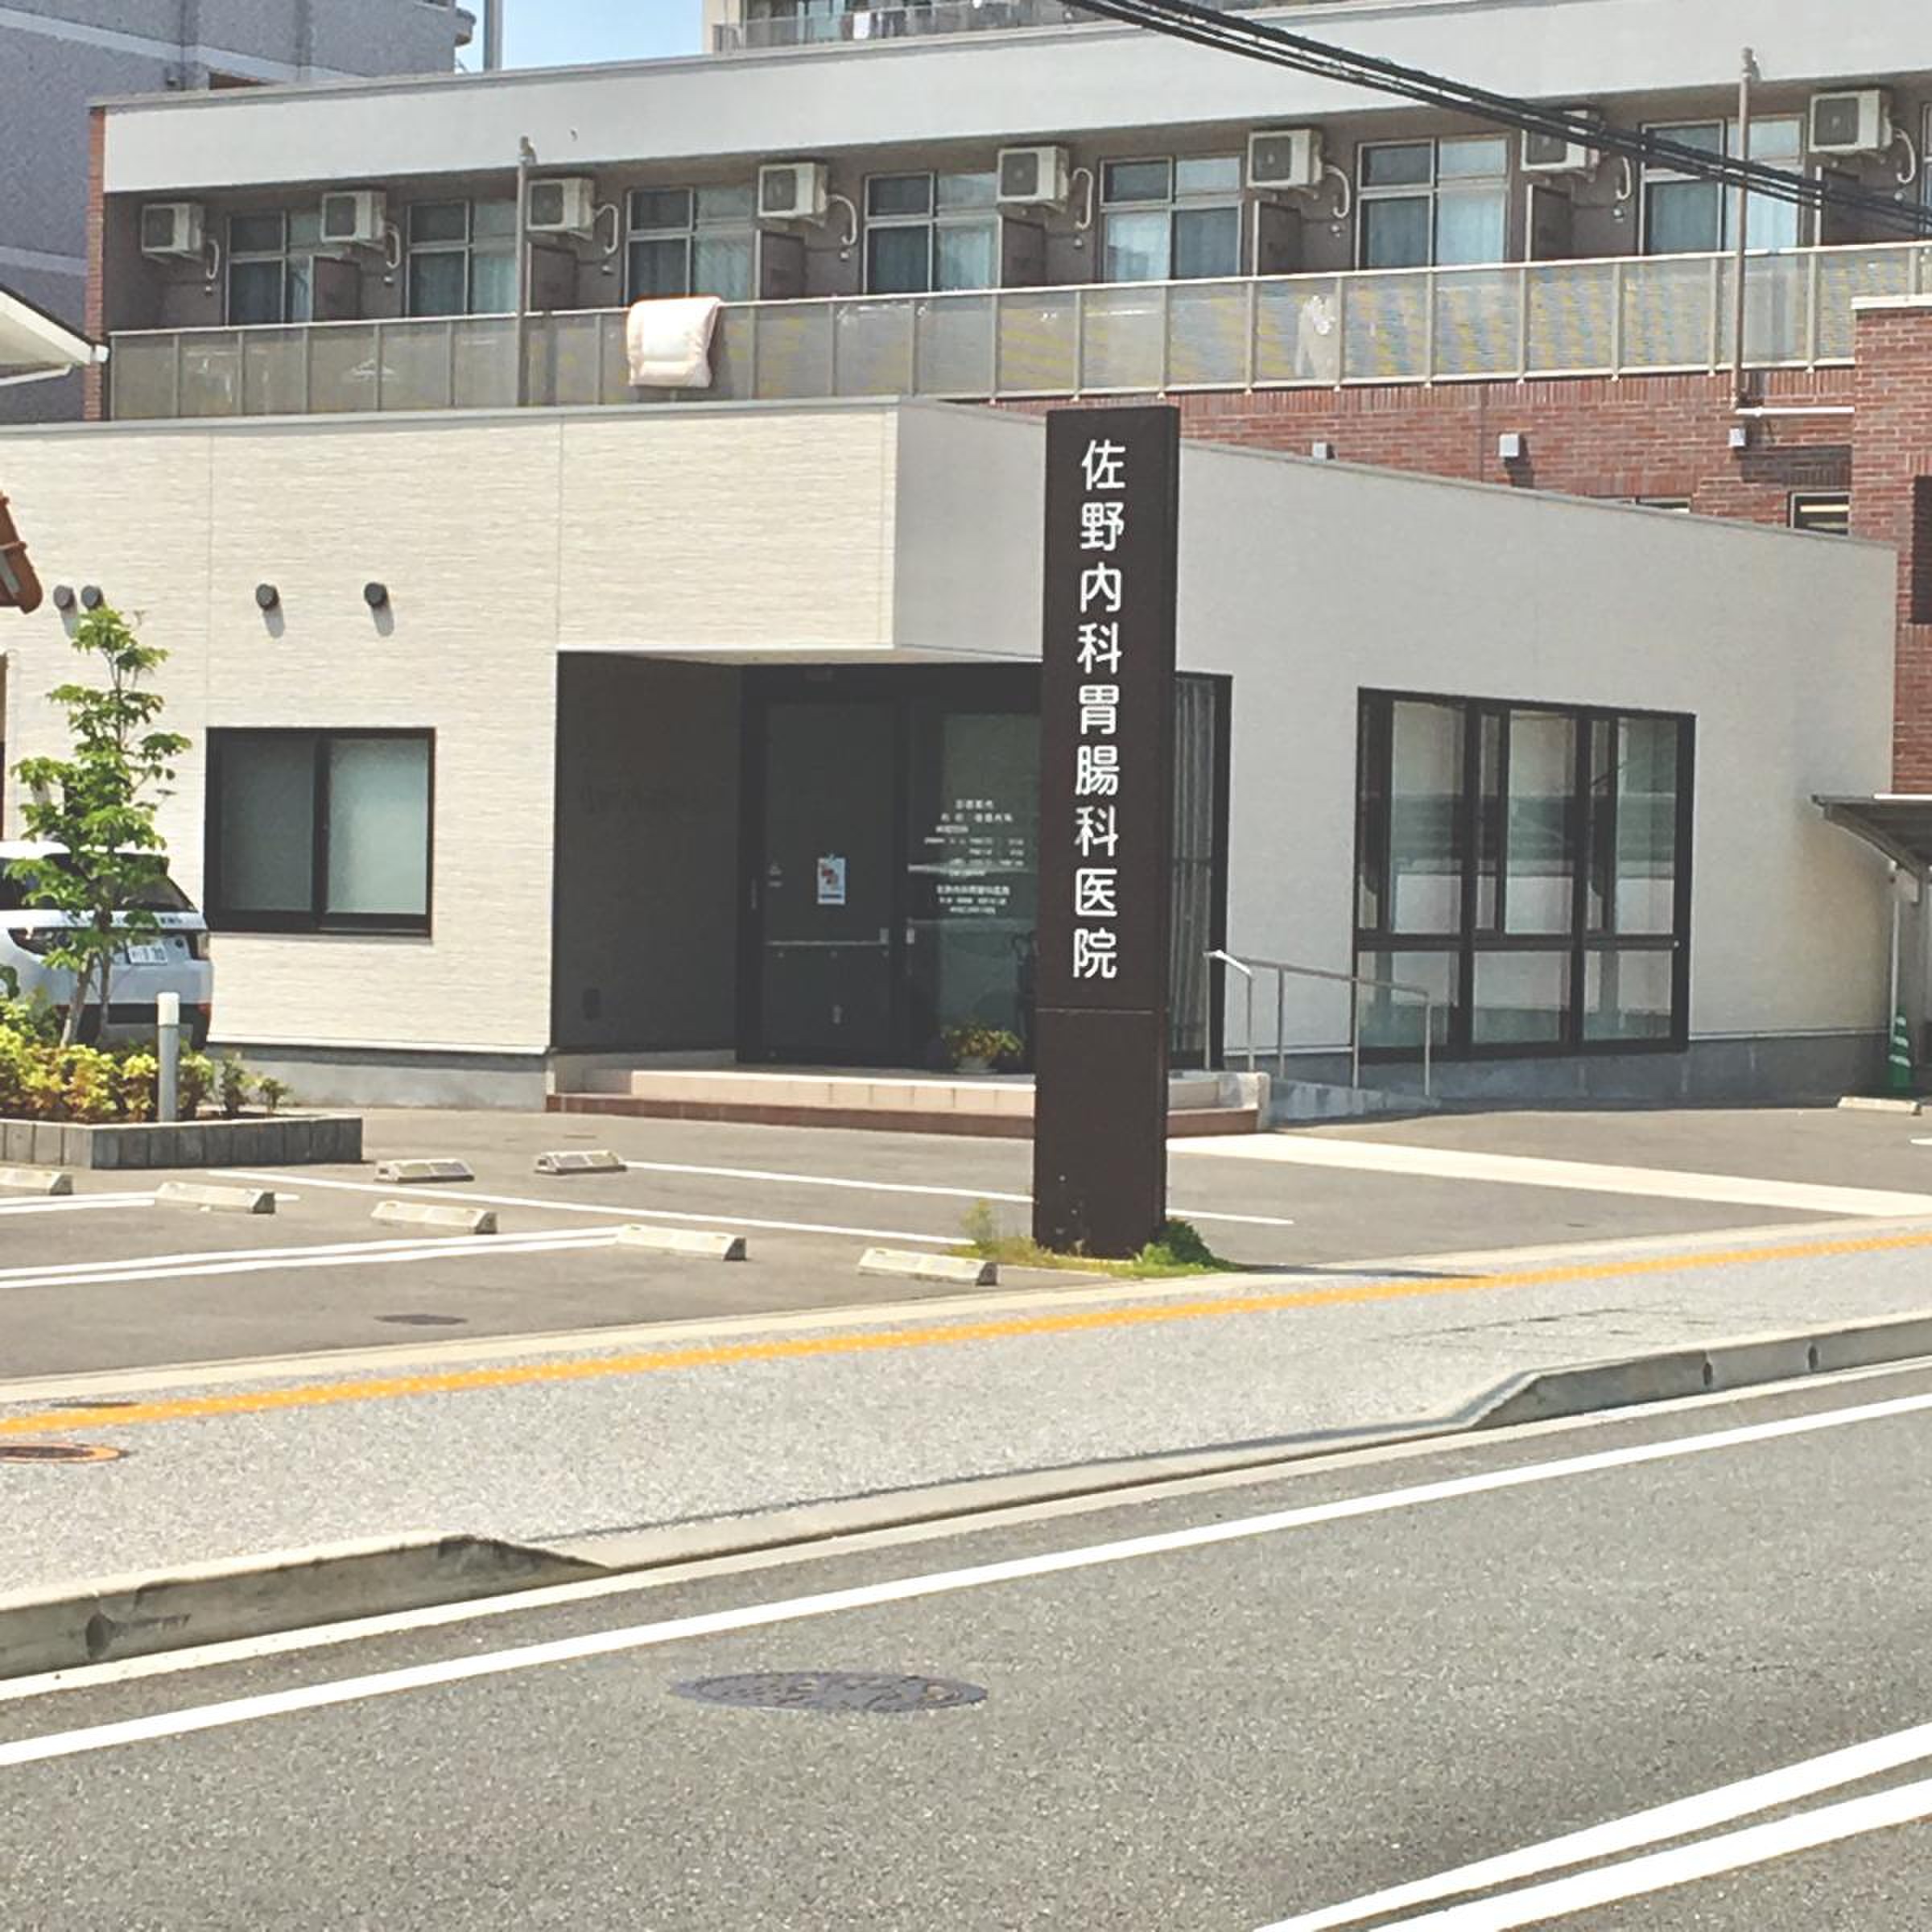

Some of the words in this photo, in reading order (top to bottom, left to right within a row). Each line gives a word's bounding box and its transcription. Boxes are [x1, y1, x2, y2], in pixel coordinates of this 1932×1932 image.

[1072, 439, 1126, 979] 佐野内科胃腸科医院
